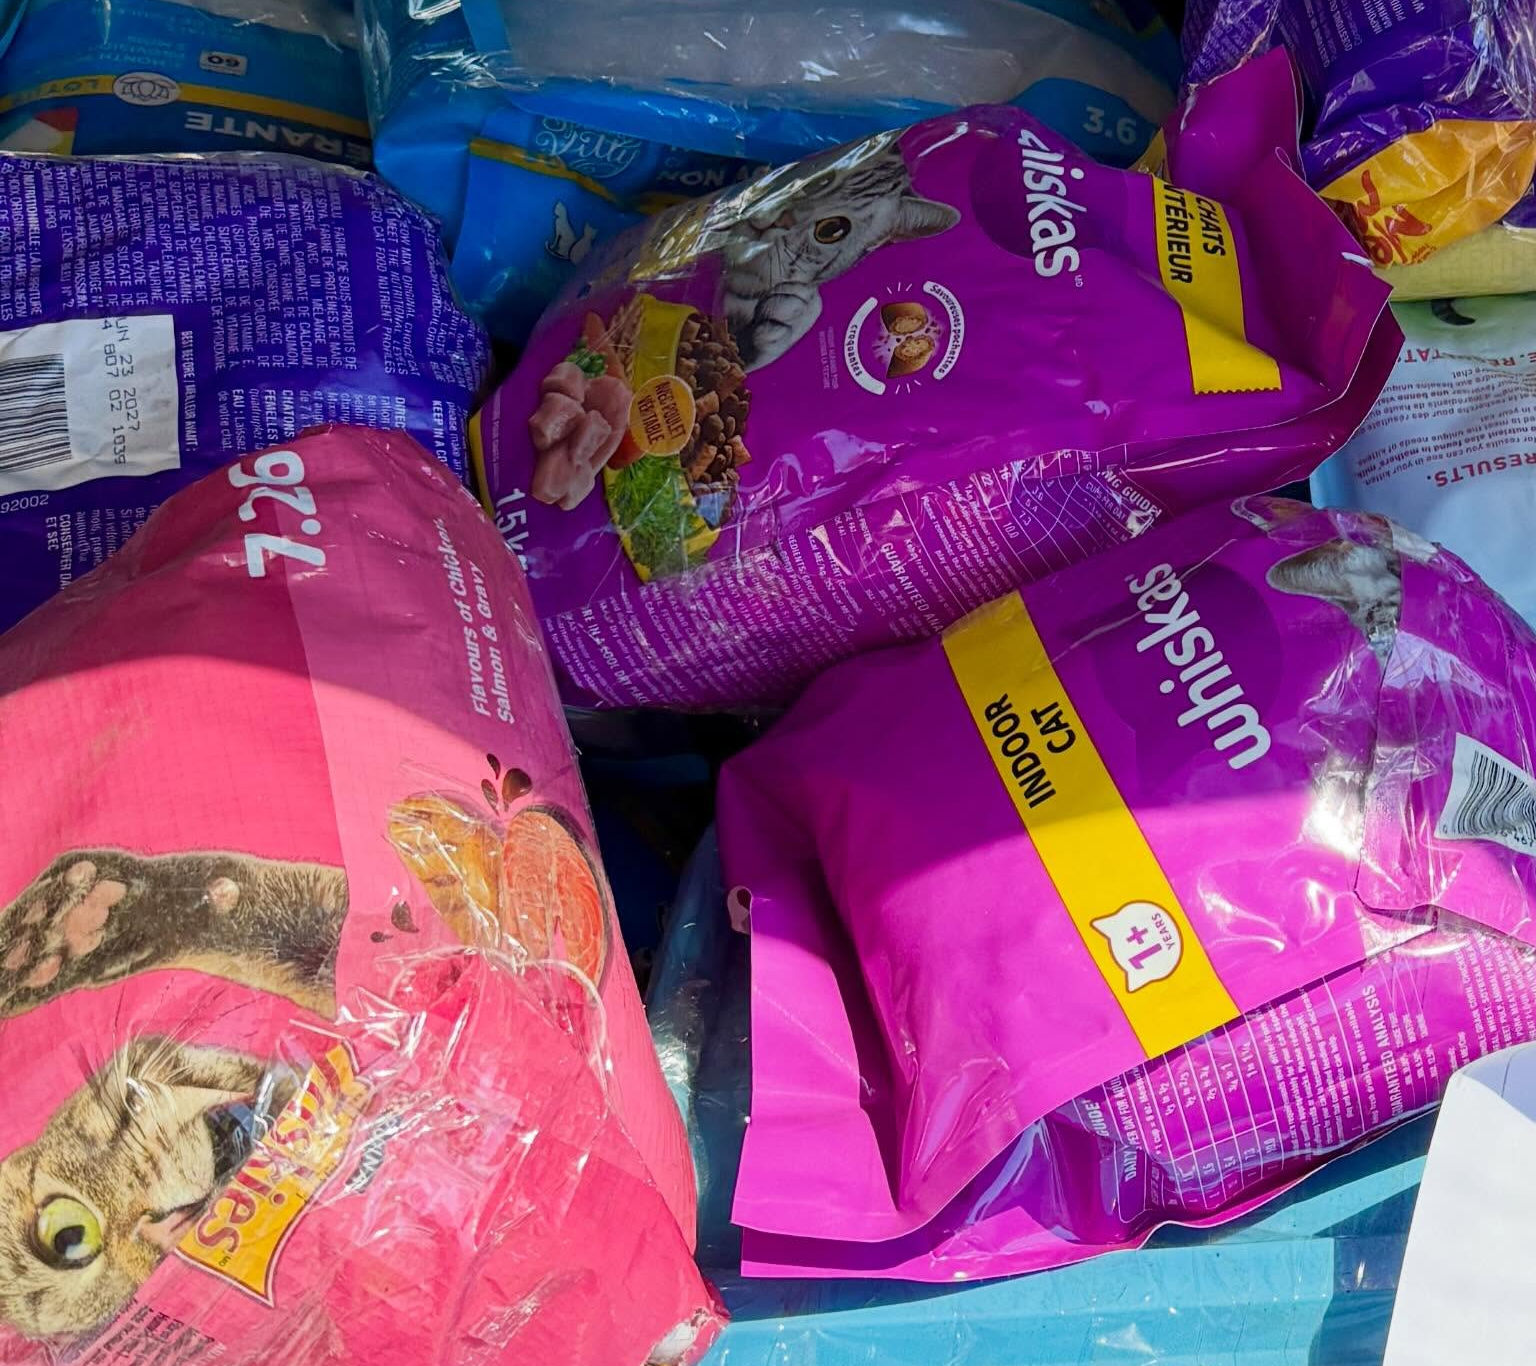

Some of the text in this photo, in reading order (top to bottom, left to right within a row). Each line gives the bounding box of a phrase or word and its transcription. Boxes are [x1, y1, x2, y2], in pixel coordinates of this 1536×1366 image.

[208, 53, 240, 68] 60
[1083, 106, 1137, 146] 3.6
[334, 226, 348, 258] FARINE
[1162, 185, 1193, 284] NTÉRIEUR
[1193, 194, 1225, 259] CHATS
[378, 275, 392, 323] NUTRIENT
[929, 284, 961, 374] Savoureuses pochettes
[119, 355, 140, 432] 23 2027
[265, 389, 277, 439] FEMELLES
[283, 389, 295, 438] CHATONS
[432, 400, 443, 426] KEEP
[109, 389, 126, 465] 02 1039
[227, 449, 327, 578] 7.26
[437, 517, 491, 718] Chicken, of Flavours
[468, 561, 516, 725] Gravy & Salmon
[1126, 561, 1273, 771] whiskas
[982, 693, 1057, 810] INDOOR
[1030, 701, 1078, 755] CAT
[1126, 918, 1166, 973] 1+
[1147, 911, 1177, 951] YEARS
[1362, 984, 1392, 1049] ANALYSIS
